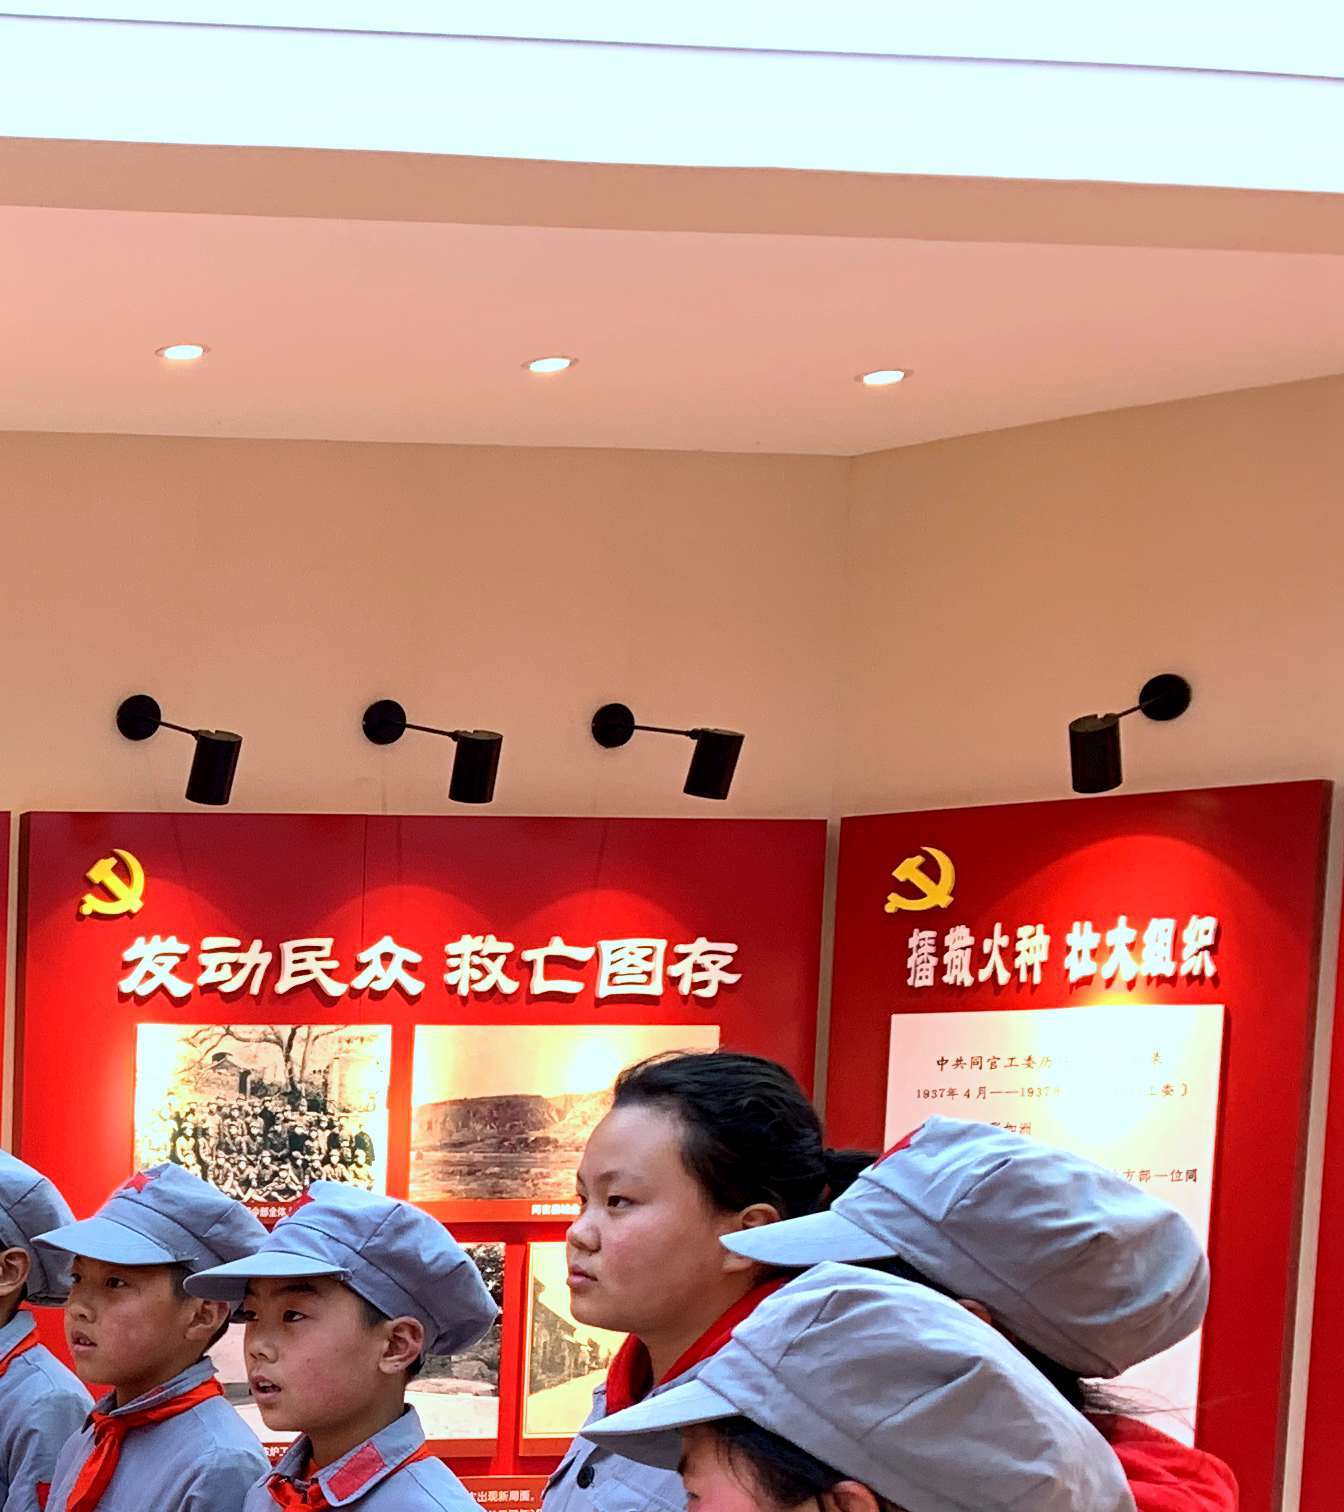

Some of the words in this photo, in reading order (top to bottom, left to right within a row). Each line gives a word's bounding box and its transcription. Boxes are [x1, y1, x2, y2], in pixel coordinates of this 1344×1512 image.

[118, 935, 426, 999] 发动民众
[443, 935, 743, 999] 救亡图存
[907, 922, 1051, 988] 播撒火种
[1063, 915, 1218, 984] 壮大组织
